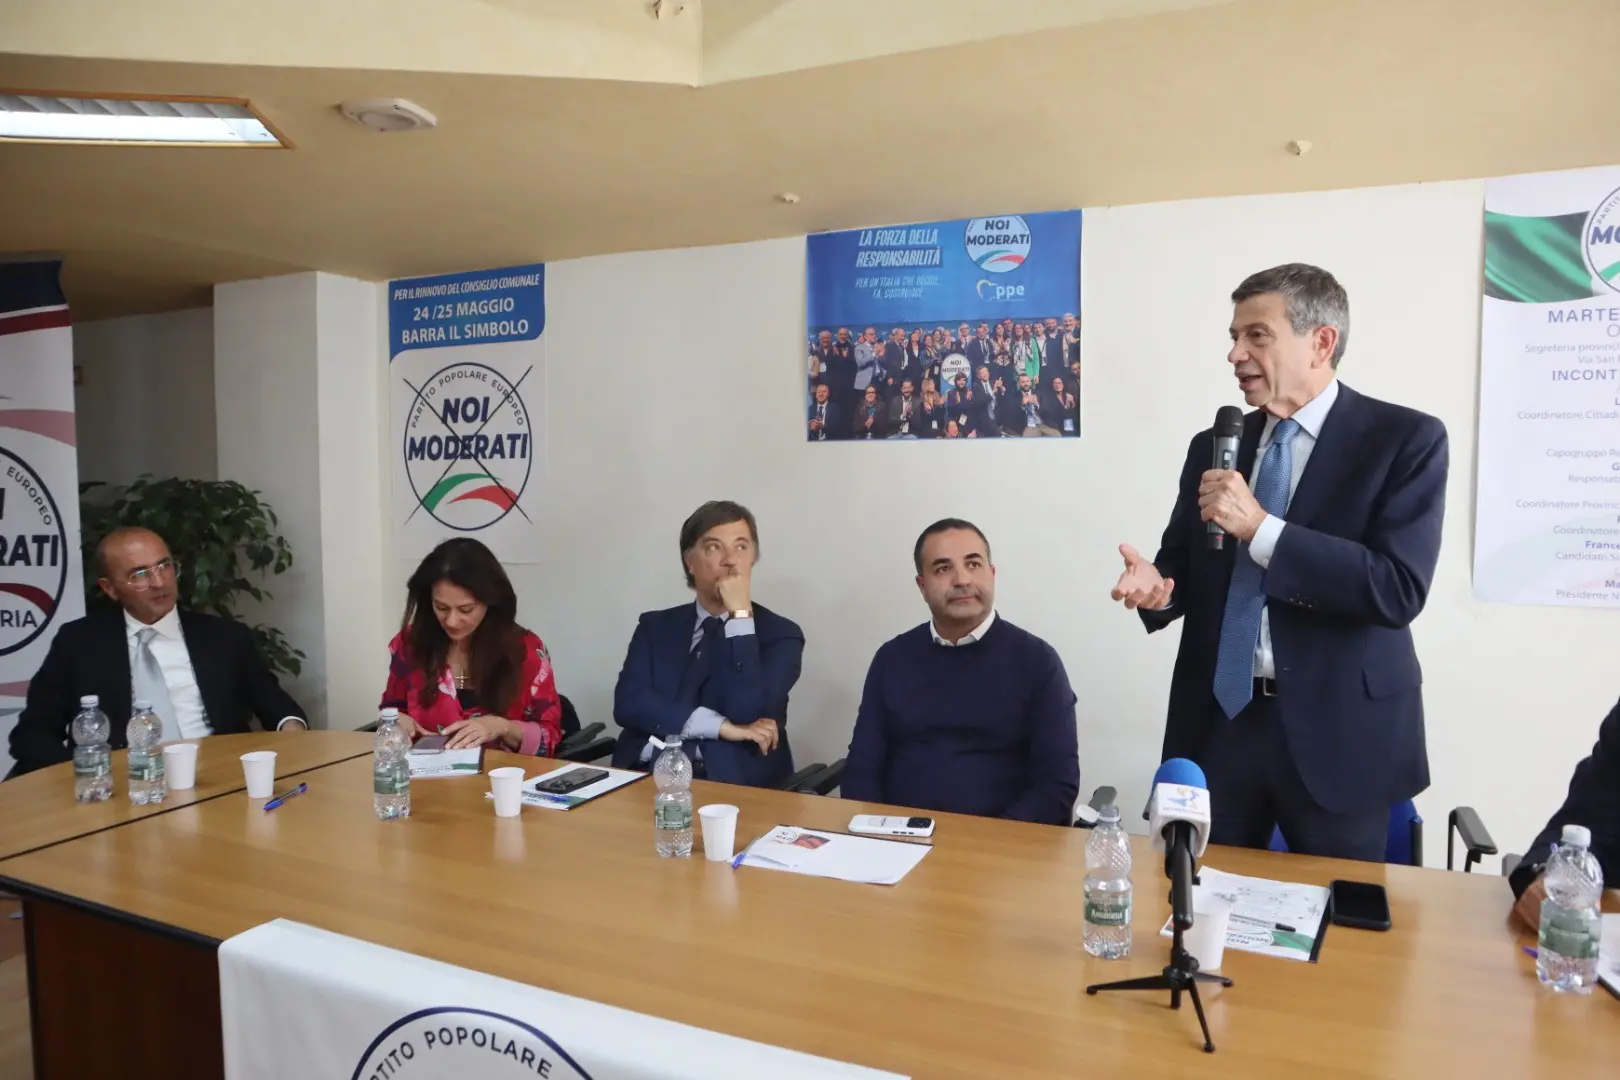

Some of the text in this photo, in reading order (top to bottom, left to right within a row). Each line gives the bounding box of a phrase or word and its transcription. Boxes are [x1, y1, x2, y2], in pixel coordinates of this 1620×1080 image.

[985, 220, 1010, 231] NOI
[859, 228, 938, 246] LA FORZA DELLA
[967, 234, 1030, 246] MODERATI
[856, 246, 940, 267] RESPONSABILITÀ
[394, 274, 540, 300] PER IL RINNOVO DEL CONSIGLIO COMUNALE
[855, 277, 868, 288] PER
[996, 285, 1025, 299] ppe
[413, 297, 515, 321] 24 /25 MAGGIO
[1548, 308, 1620, 323] MARTE
[402, 319, 529, 344] BARRA IL SIMBOLO
[1524, 343, 1576, 354] Segreteria
[1578, 355, 1593, 364] Via
[1596, 355, 1615, 364] San
[1552, 369, 1618, 381] INCONT
[411, 370, 524, 428] PARTTO POPOLARE EUROPEO
[442, 396, 490, 424] NOI
[1517, 410, 1583, 420] Coordinatore
[408, 433, 528, 461] MODERATI
[1545, 448, 1607, 458] Capogruppo
[6, 466, 52, 525] EUROPEO
[1516, 499, 1580, 509] Coordinatore
[1553, 525, 1620, 535] Coordinatore
[1555, 551, 1608, 561] Candidato
[1556, 590, 1609, 600] Presidente
[424, 1026, 553, 1080] POPOLARE
